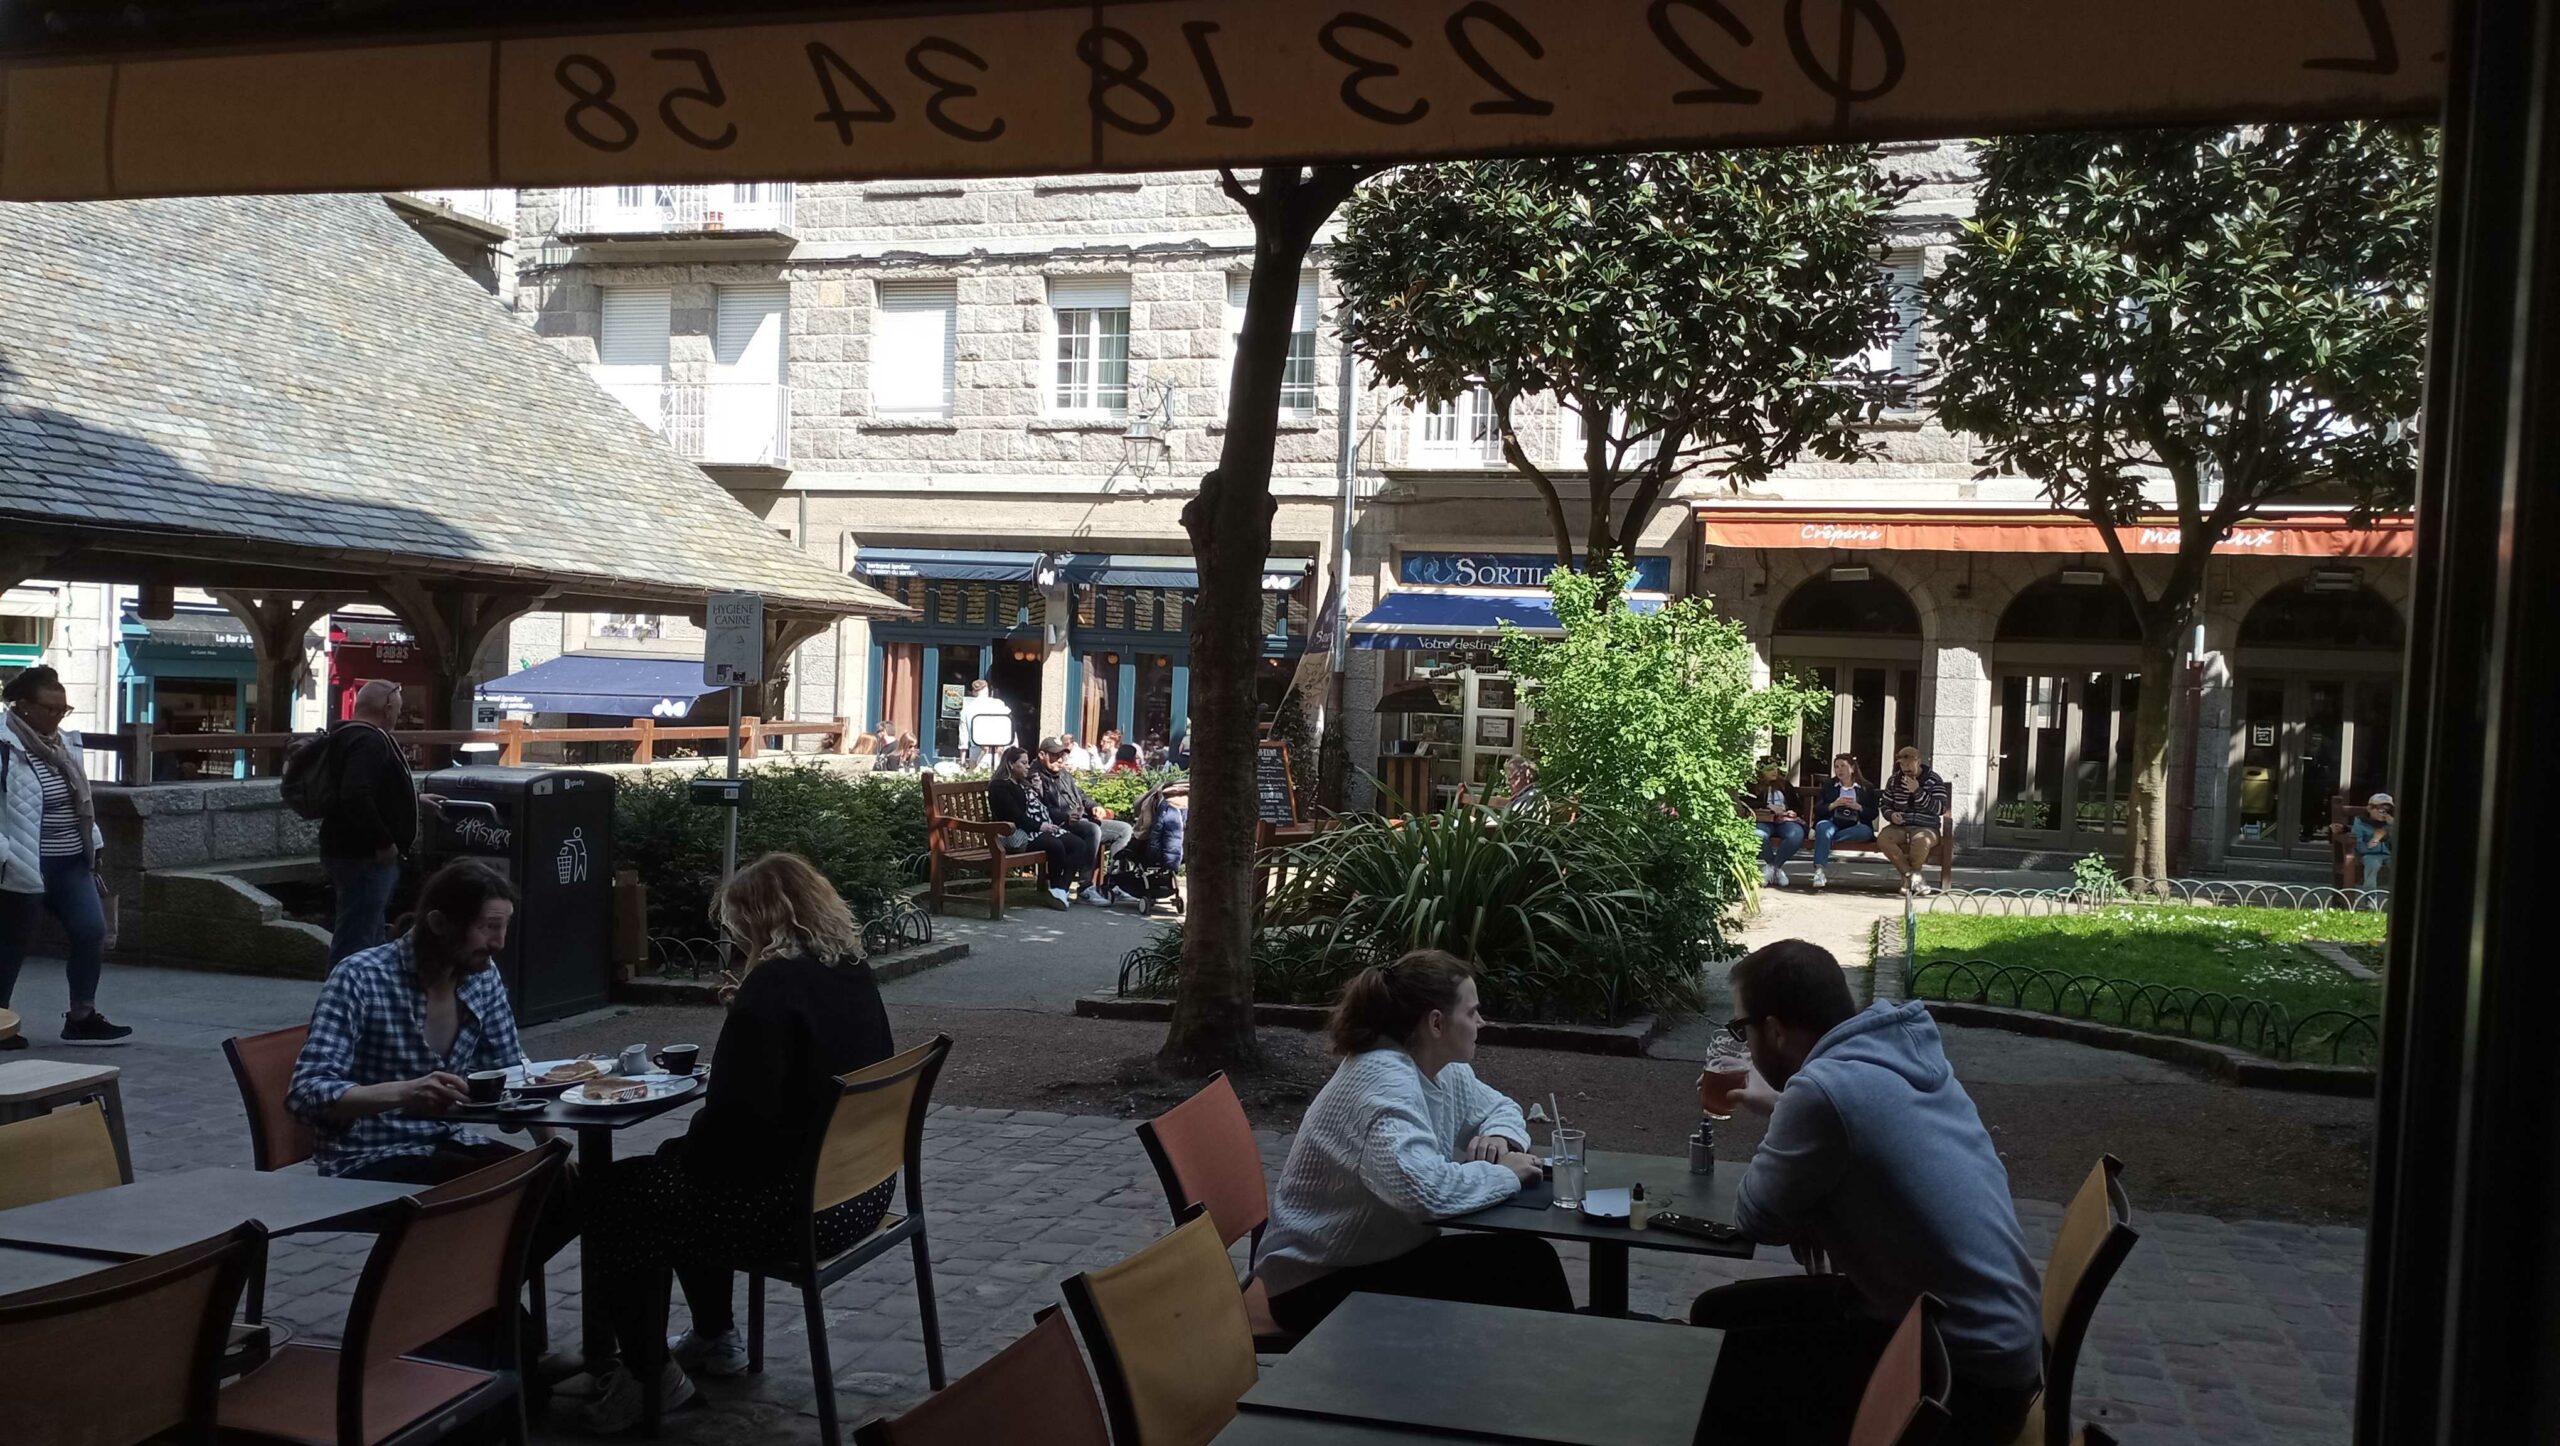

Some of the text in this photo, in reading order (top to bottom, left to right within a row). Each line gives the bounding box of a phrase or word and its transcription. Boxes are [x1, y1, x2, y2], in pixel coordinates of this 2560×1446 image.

[1801, 523, 1882, 547] Crêperie
[1455, 557, 1561, 587] SORTIL
[713, 601, 753, 615] HYGIÈNE
[714, 614, 751, 625] CANINE
[215, 633, 226, 643] Le
[225, 634, 239, 643] Bar
[1417, 635, 1451, 649] Votre
[1428, 661, 1500, 678] toujours aussi
